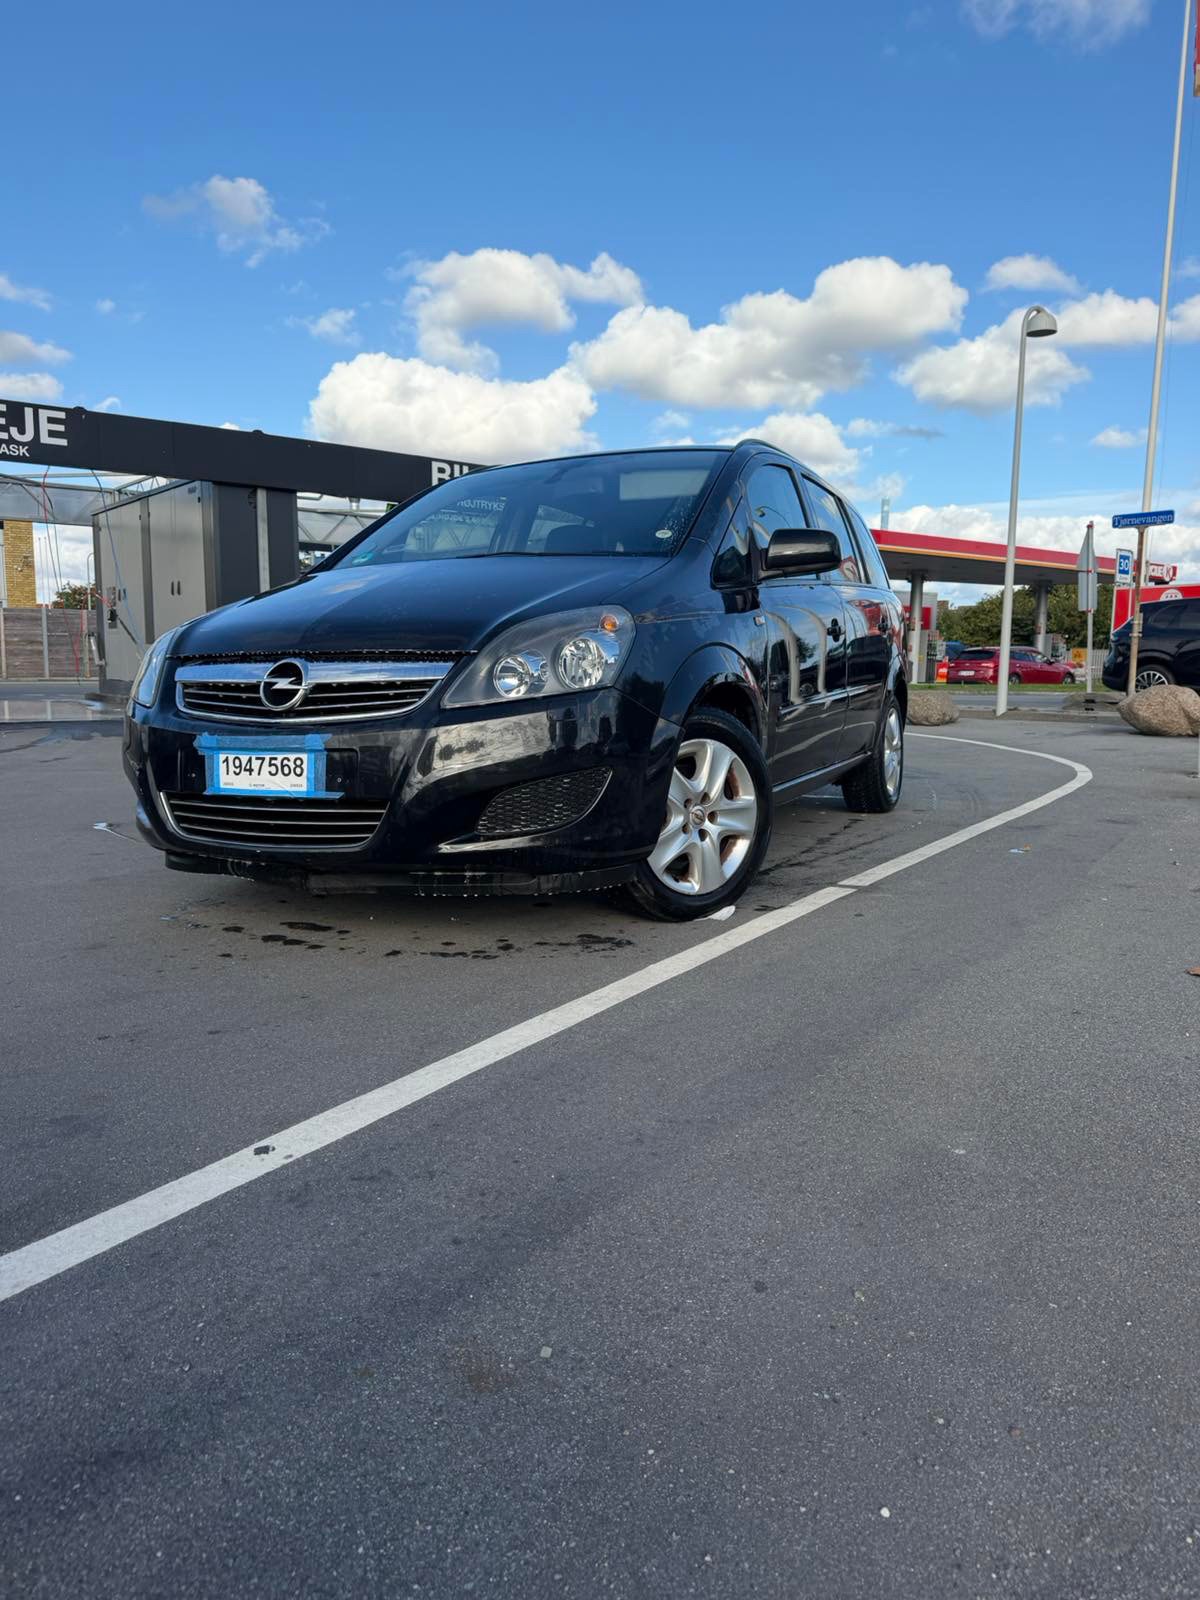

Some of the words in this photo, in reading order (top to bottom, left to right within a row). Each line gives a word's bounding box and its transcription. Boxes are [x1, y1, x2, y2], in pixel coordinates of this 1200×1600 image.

[1113, 515, 1173, 528] Tjørnevangen
[1120, 559, 1129, 571] 30
[222, 755, 304, 777] 1947568
